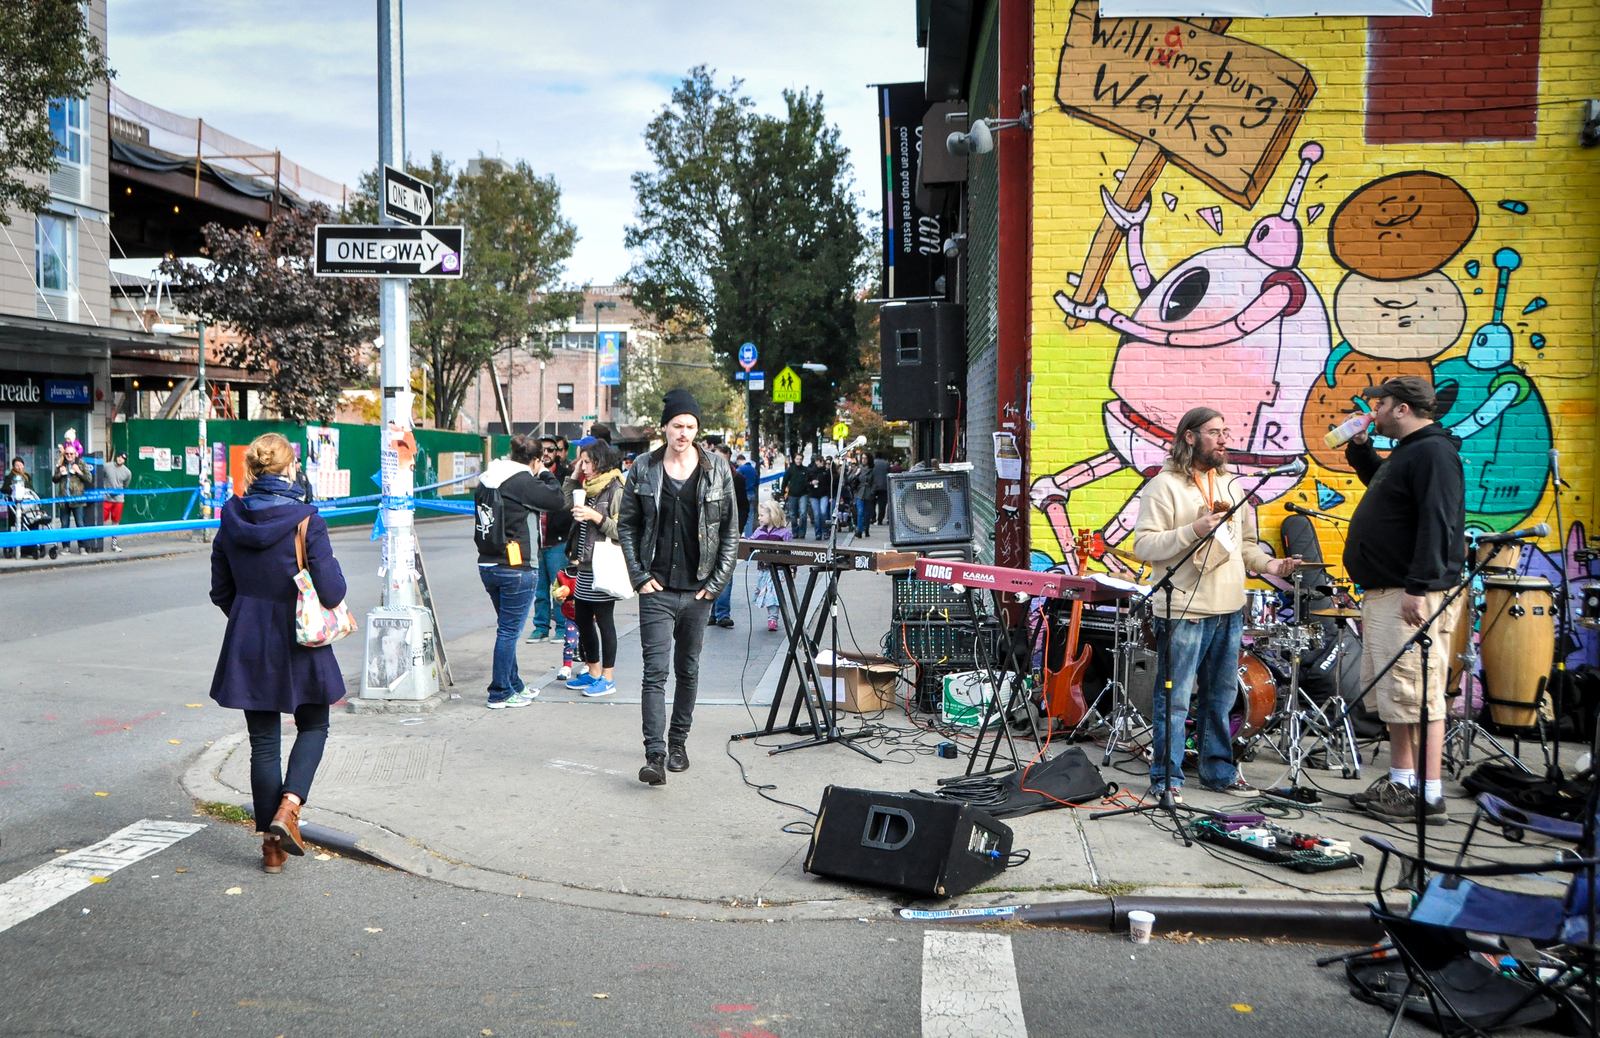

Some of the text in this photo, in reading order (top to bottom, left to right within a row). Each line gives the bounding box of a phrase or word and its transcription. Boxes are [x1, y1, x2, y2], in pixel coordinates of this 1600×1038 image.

[900, 126, 912, 253] corcoran group real estate
[392, 185, 428, 217] ONE WAY
[337, 241, 439, 261] ONE WAY
[916, 481, 944, 490] Roland
[925, 564, 952, 580] KORG
[963, 571, 995, 580] KARMA
[375, 619, 397, 628] FUCK
